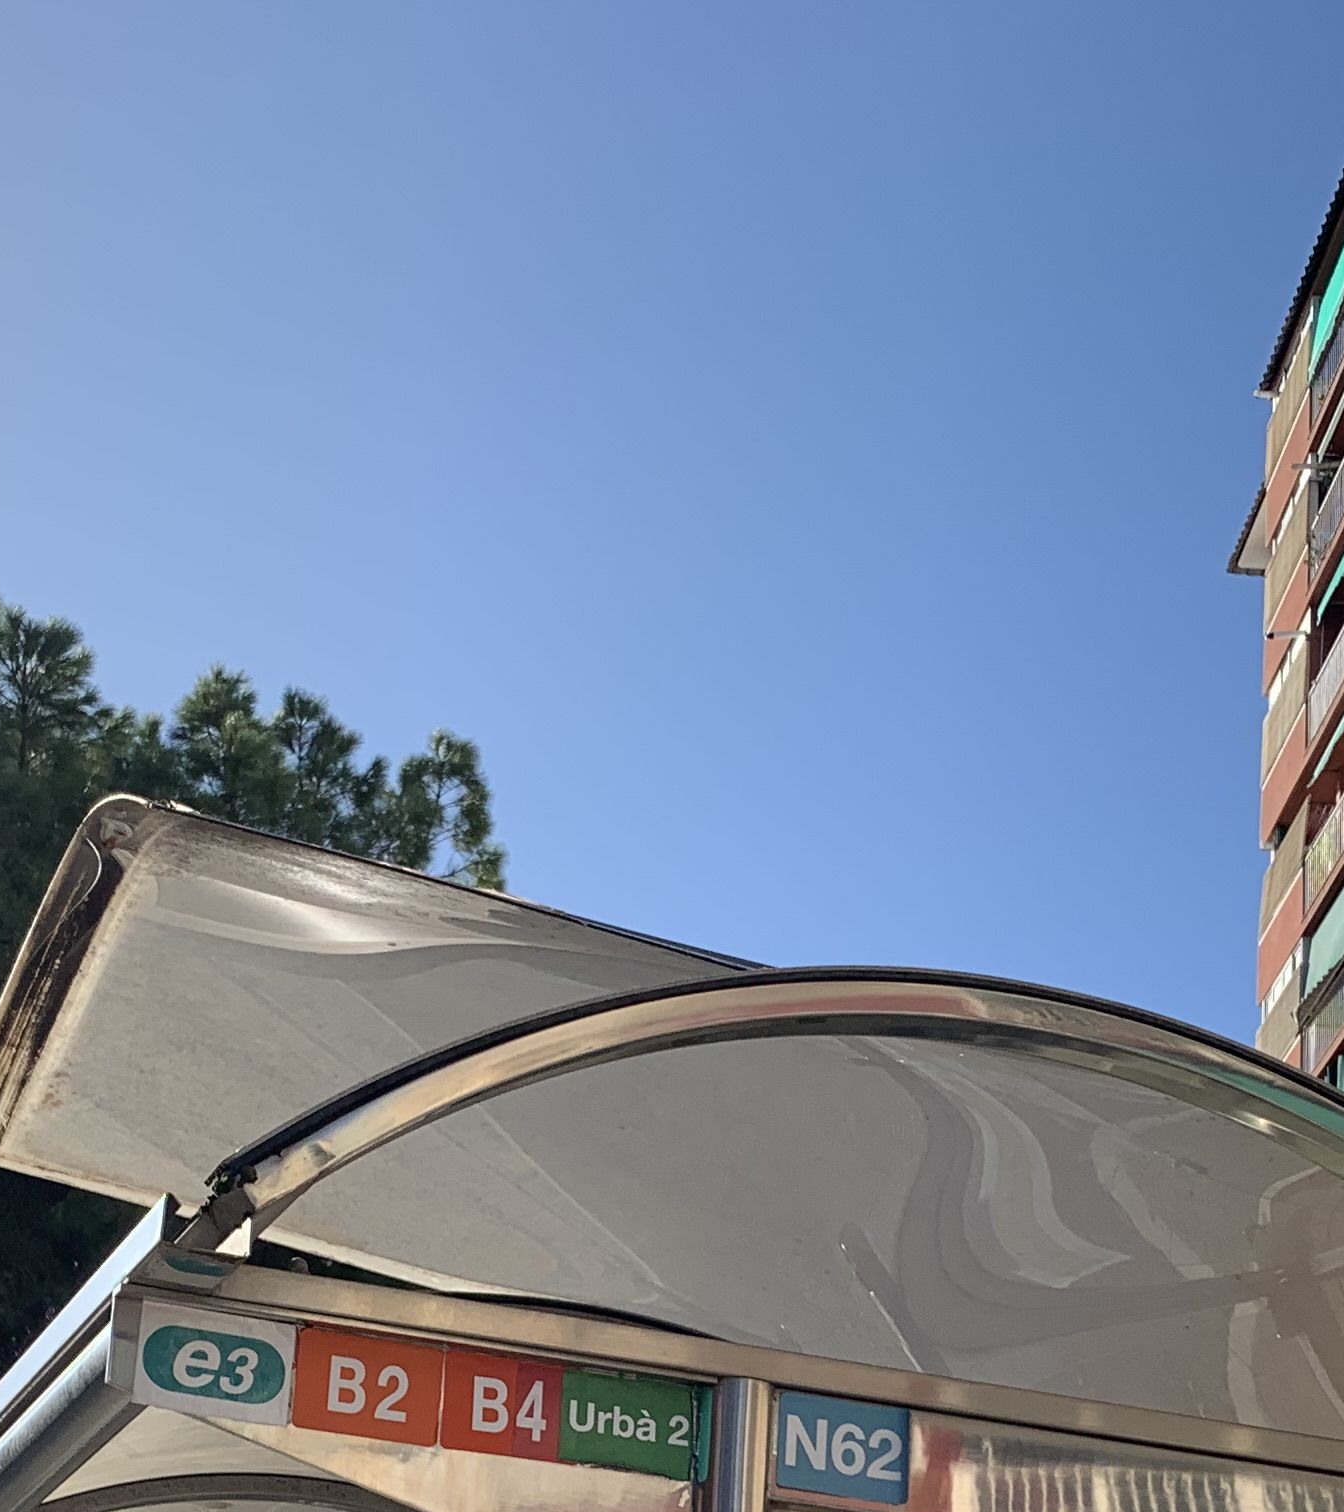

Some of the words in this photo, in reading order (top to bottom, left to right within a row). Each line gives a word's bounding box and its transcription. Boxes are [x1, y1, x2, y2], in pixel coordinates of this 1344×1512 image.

[172, 1339, 259, 1395] e3
[327, 1354, 409, 1423] B2
[471, 1375, 547, 1442] B4
[568, 1399, 657, 1443] Urbà
[667, 1414, 690, 1447] 2
[784, 1413, 903, 1482] N62
